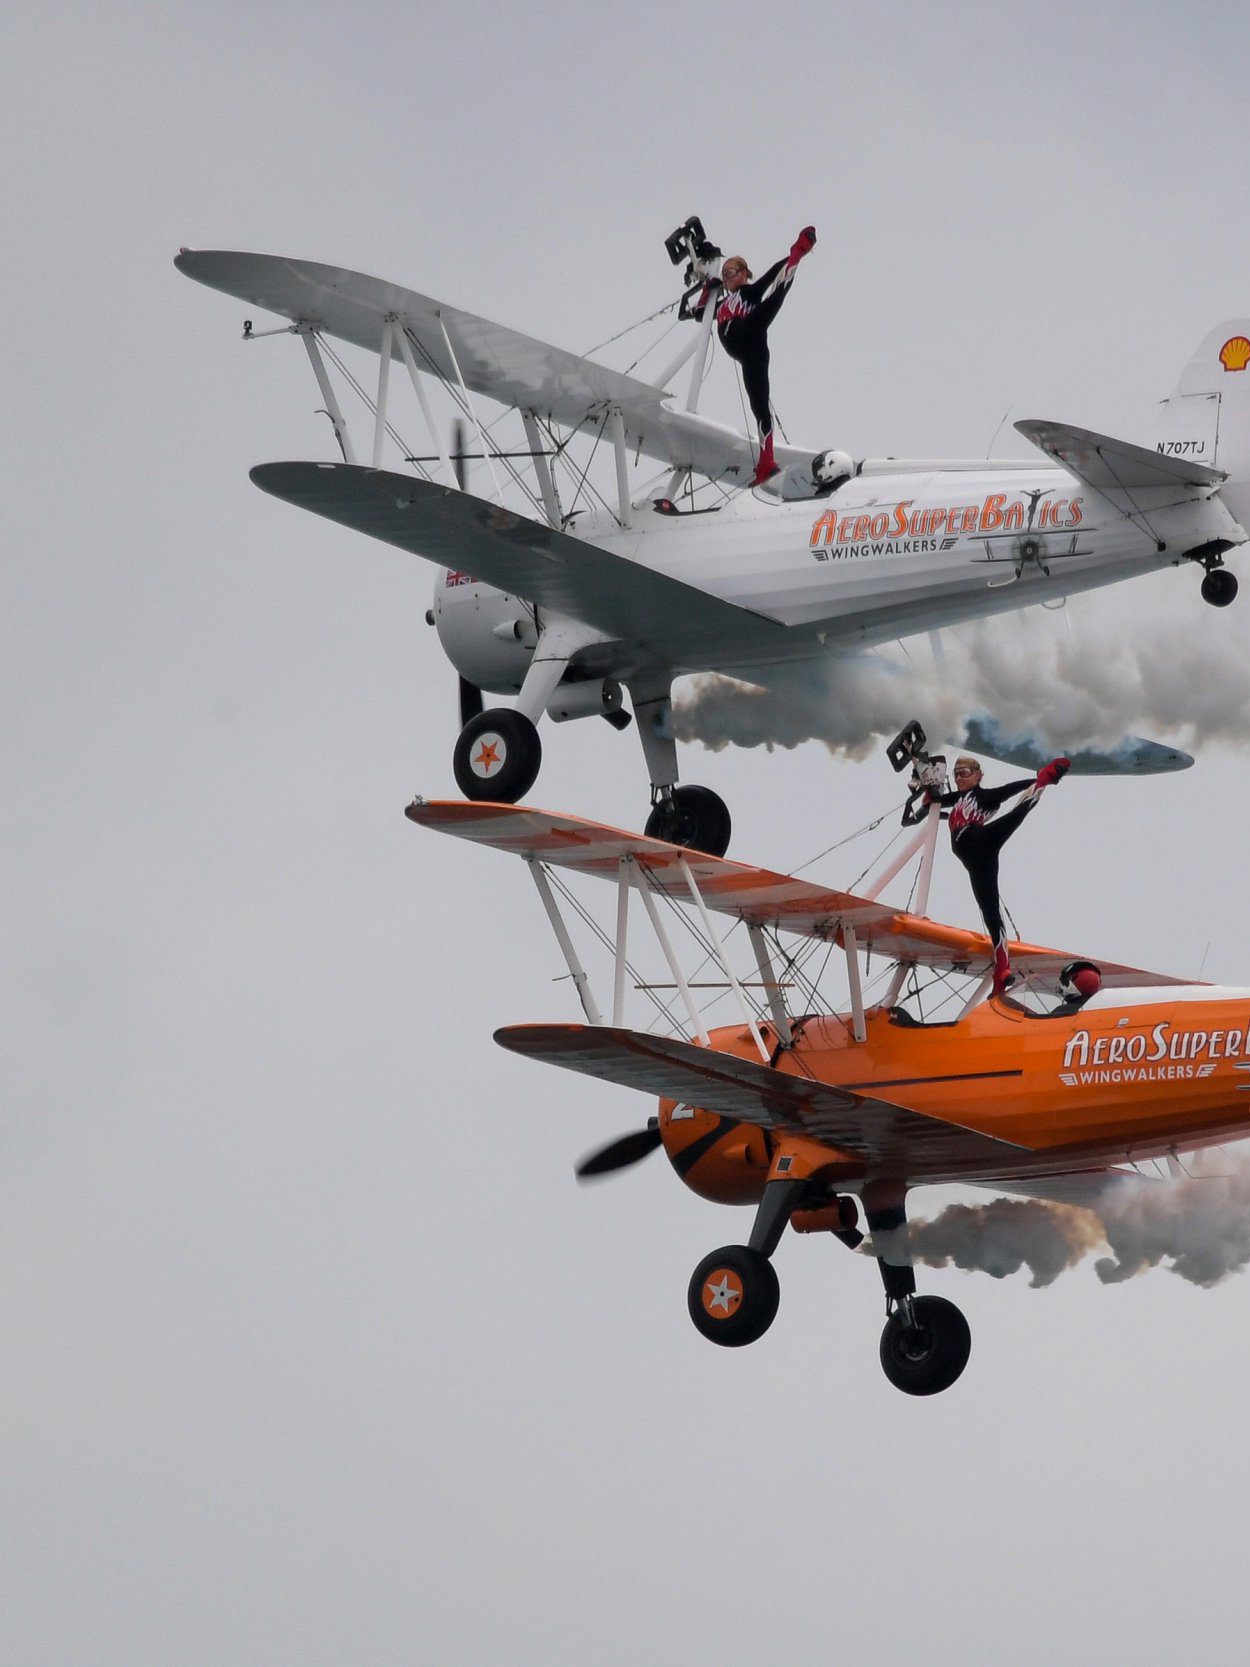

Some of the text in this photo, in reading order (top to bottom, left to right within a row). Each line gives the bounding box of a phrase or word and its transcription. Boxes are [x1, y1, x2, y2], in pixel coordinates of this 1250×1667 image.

[1157, 441, 1205, 454] N707TJ
[830, 540, 937, 560] WINGWALKERS
[1079, 1065, 1194, 1085] WINGWALKERS
